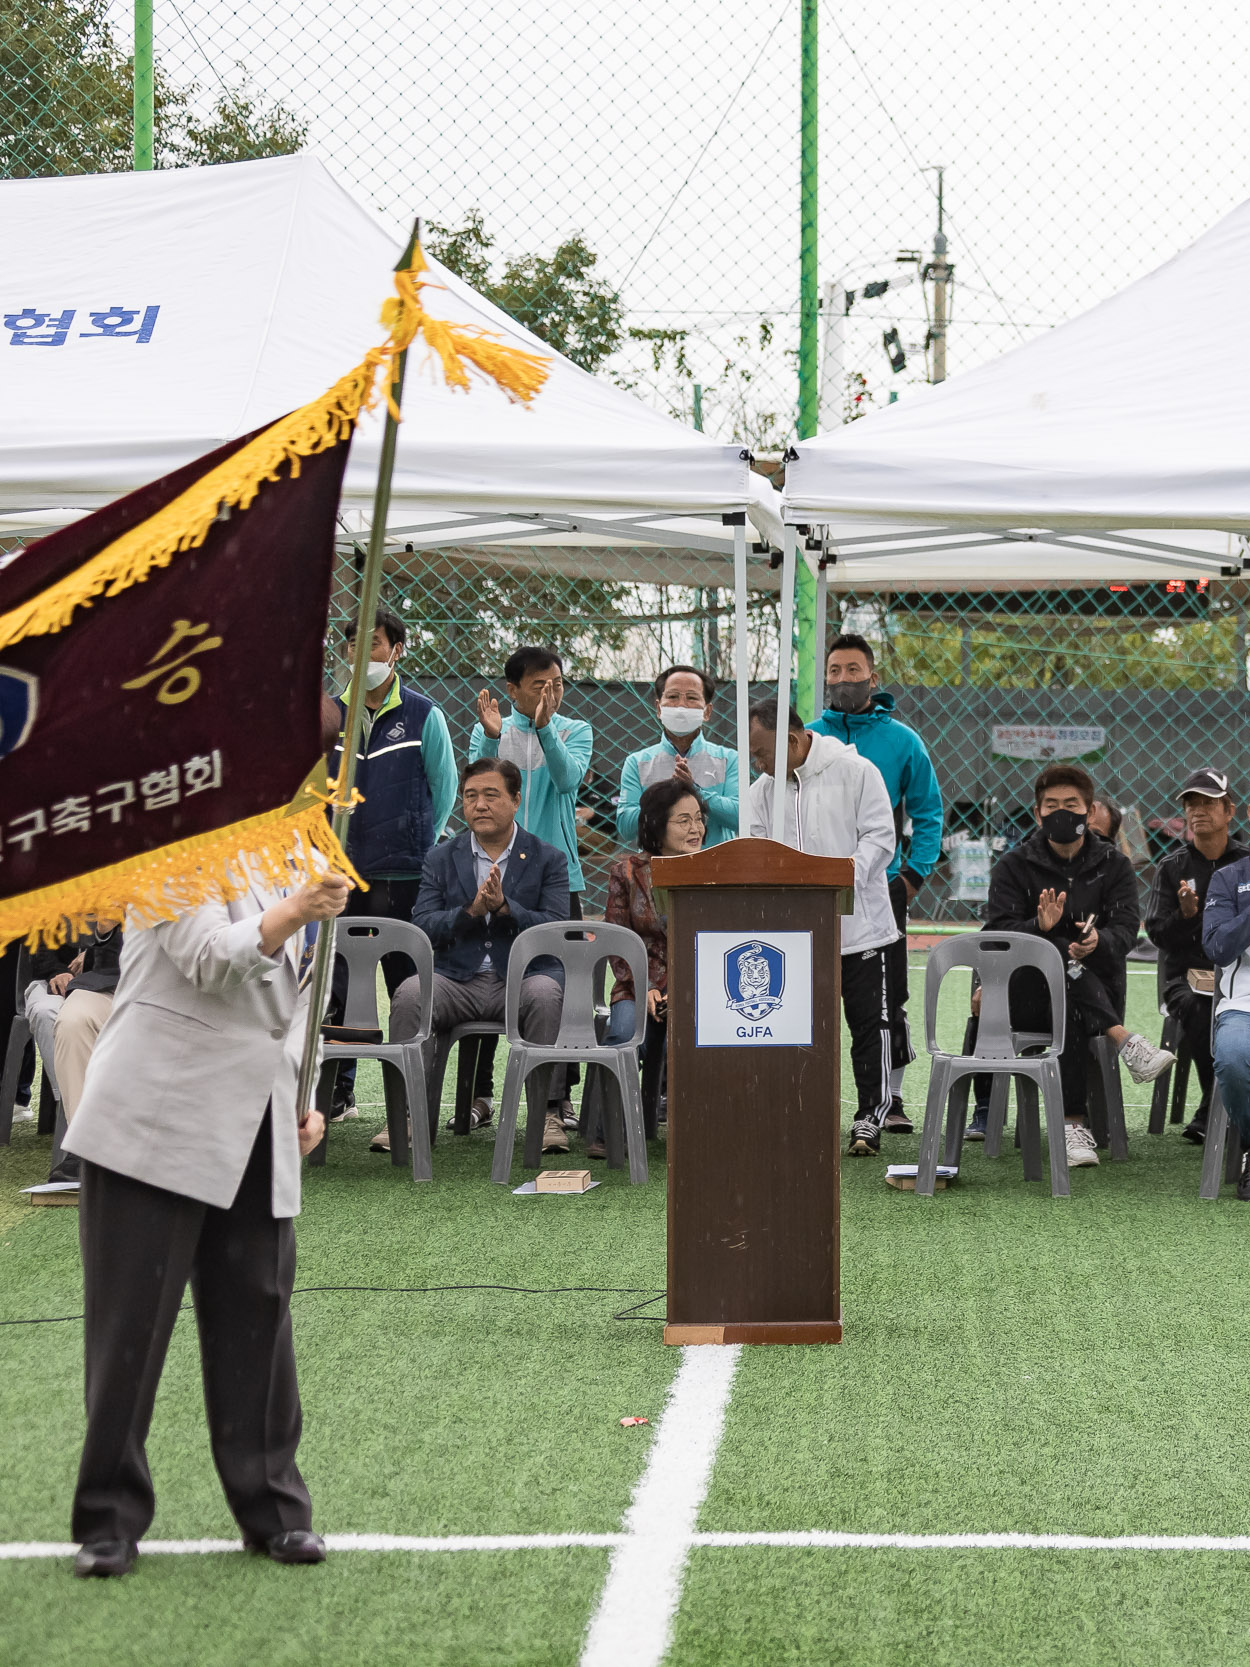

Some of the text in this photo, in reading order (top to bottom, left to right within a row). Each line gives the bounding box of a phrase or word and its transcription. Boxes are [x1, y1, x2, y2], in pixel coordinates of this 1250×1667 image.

[3, 305, 161, 347] 협회
[120, 619, 223, 705] 승
[0, 749, 222, 858] 구축구협회
[736, 1026, 774, 1038] GJFA
